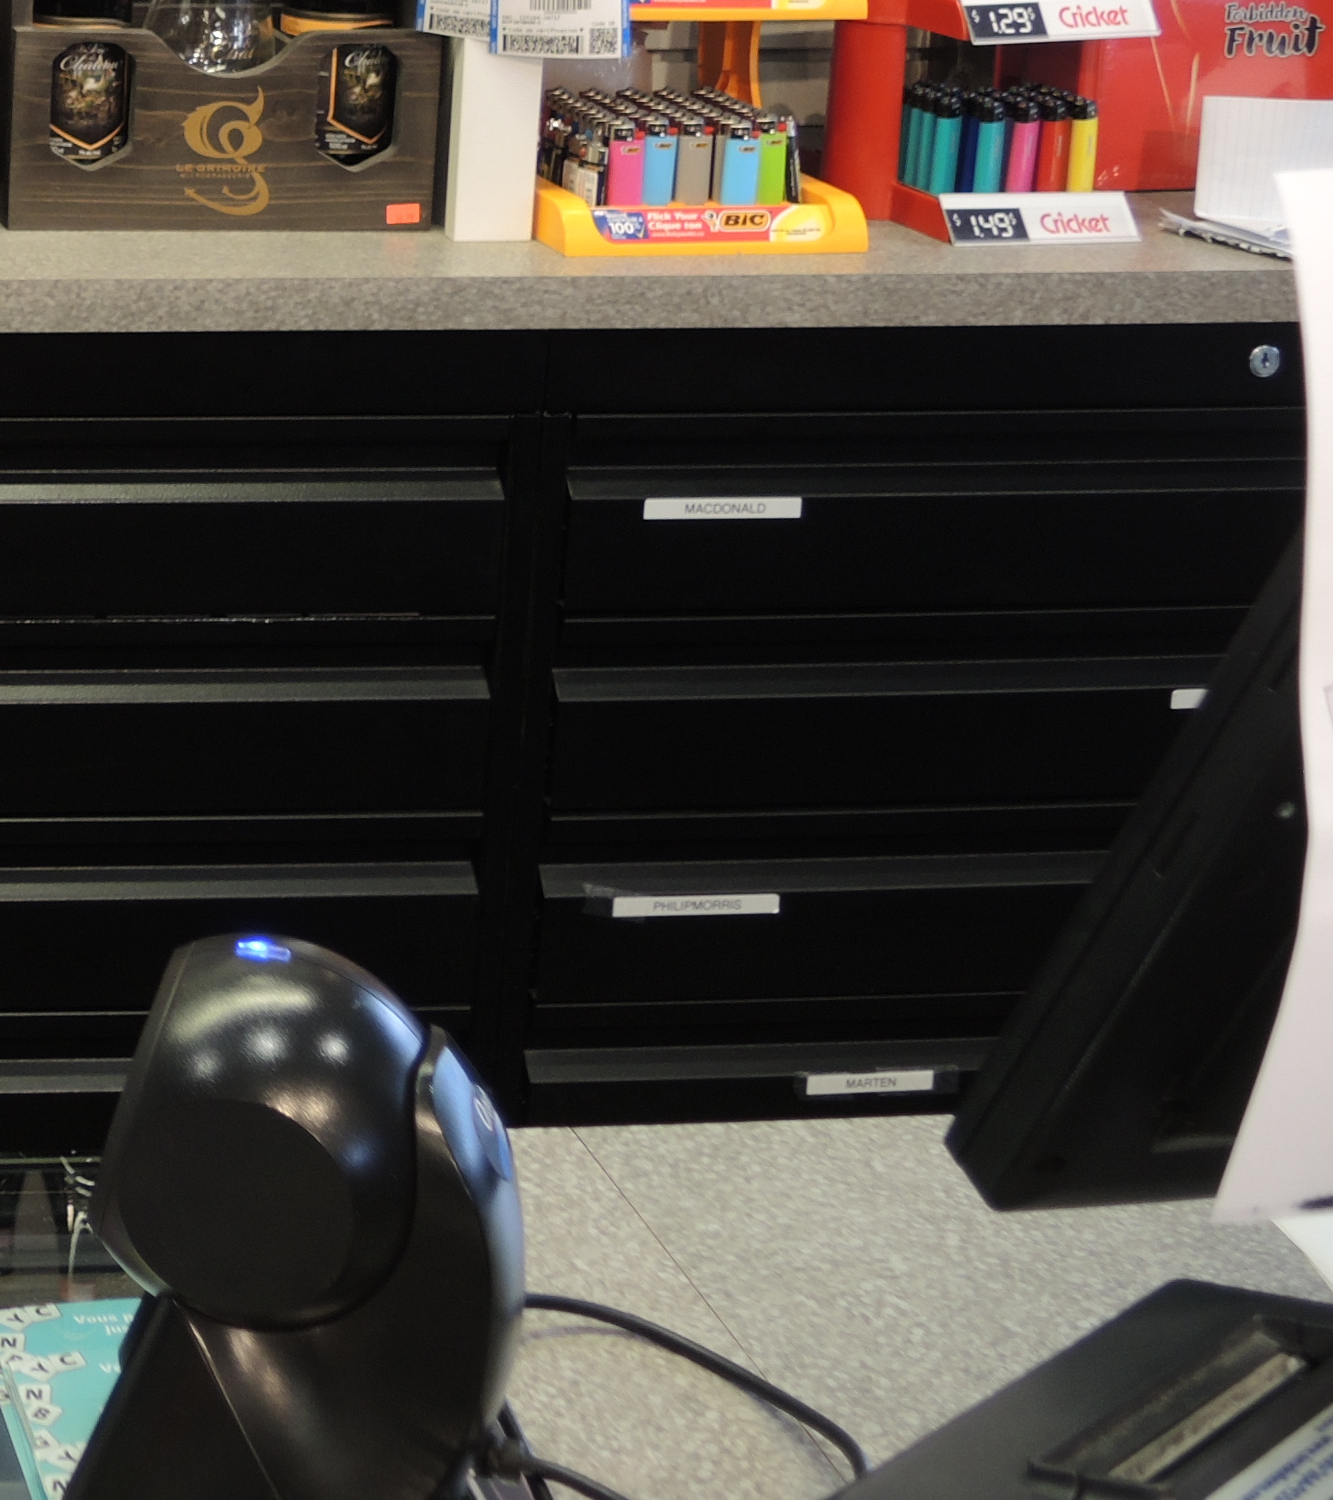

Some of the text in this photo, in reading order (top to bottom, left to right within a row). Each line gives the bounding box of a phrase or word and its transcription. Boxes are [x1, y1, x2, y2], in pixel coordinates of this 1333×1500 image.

[1058, 4, 1130, 29] Cricket
[1225, 1, 1308, 23] Forbidden
[1224, 15, 1326, 58] Fruit
[1040, 212, 1112, 236] Cricket
[683, 501, 767, 515] MACDONALD
[652, 898, 742, 912] PHILIPMORRIS
[845, 1076, 897, 1089] MARTEN
